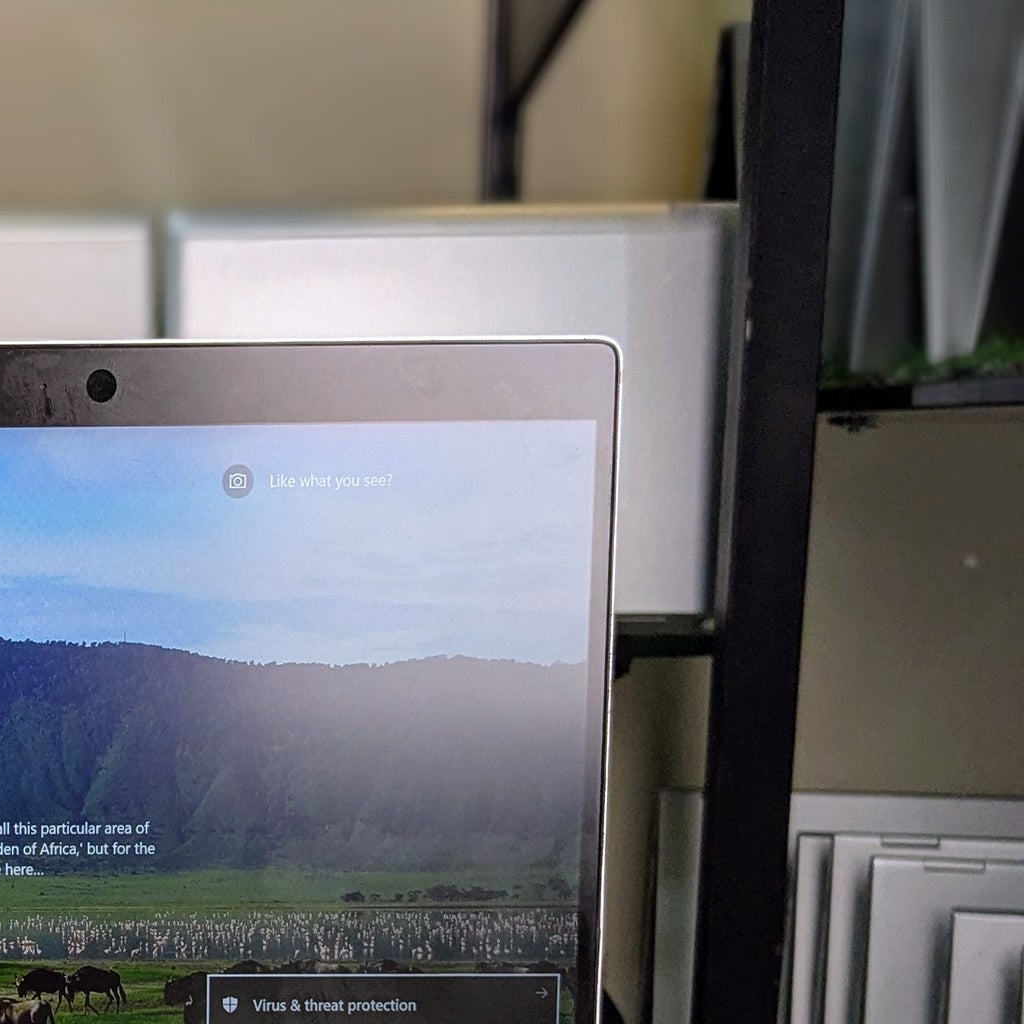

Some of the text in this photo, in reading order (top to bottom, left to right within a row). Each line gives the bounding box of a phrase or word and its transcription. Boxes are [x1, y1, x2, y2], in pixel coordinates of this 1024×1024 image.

[269, 473, 394, 491] Like what you see?
[13, 821, 38, 836] this
[40, 821, 102, 839] particular
[104, 824, 133, 836] area
[135, 820, 151, 836] of
[22, 841, 38, 856] of
[39, 841, 84, 858] Africa,'
[87, 841, 110, 856] but
[112, 841, 133, 856] for
[134, 841, 156, 856] the
[4, 862, 45, 876] here...
[252, 998, 418, 1015] Virus & threat protection
